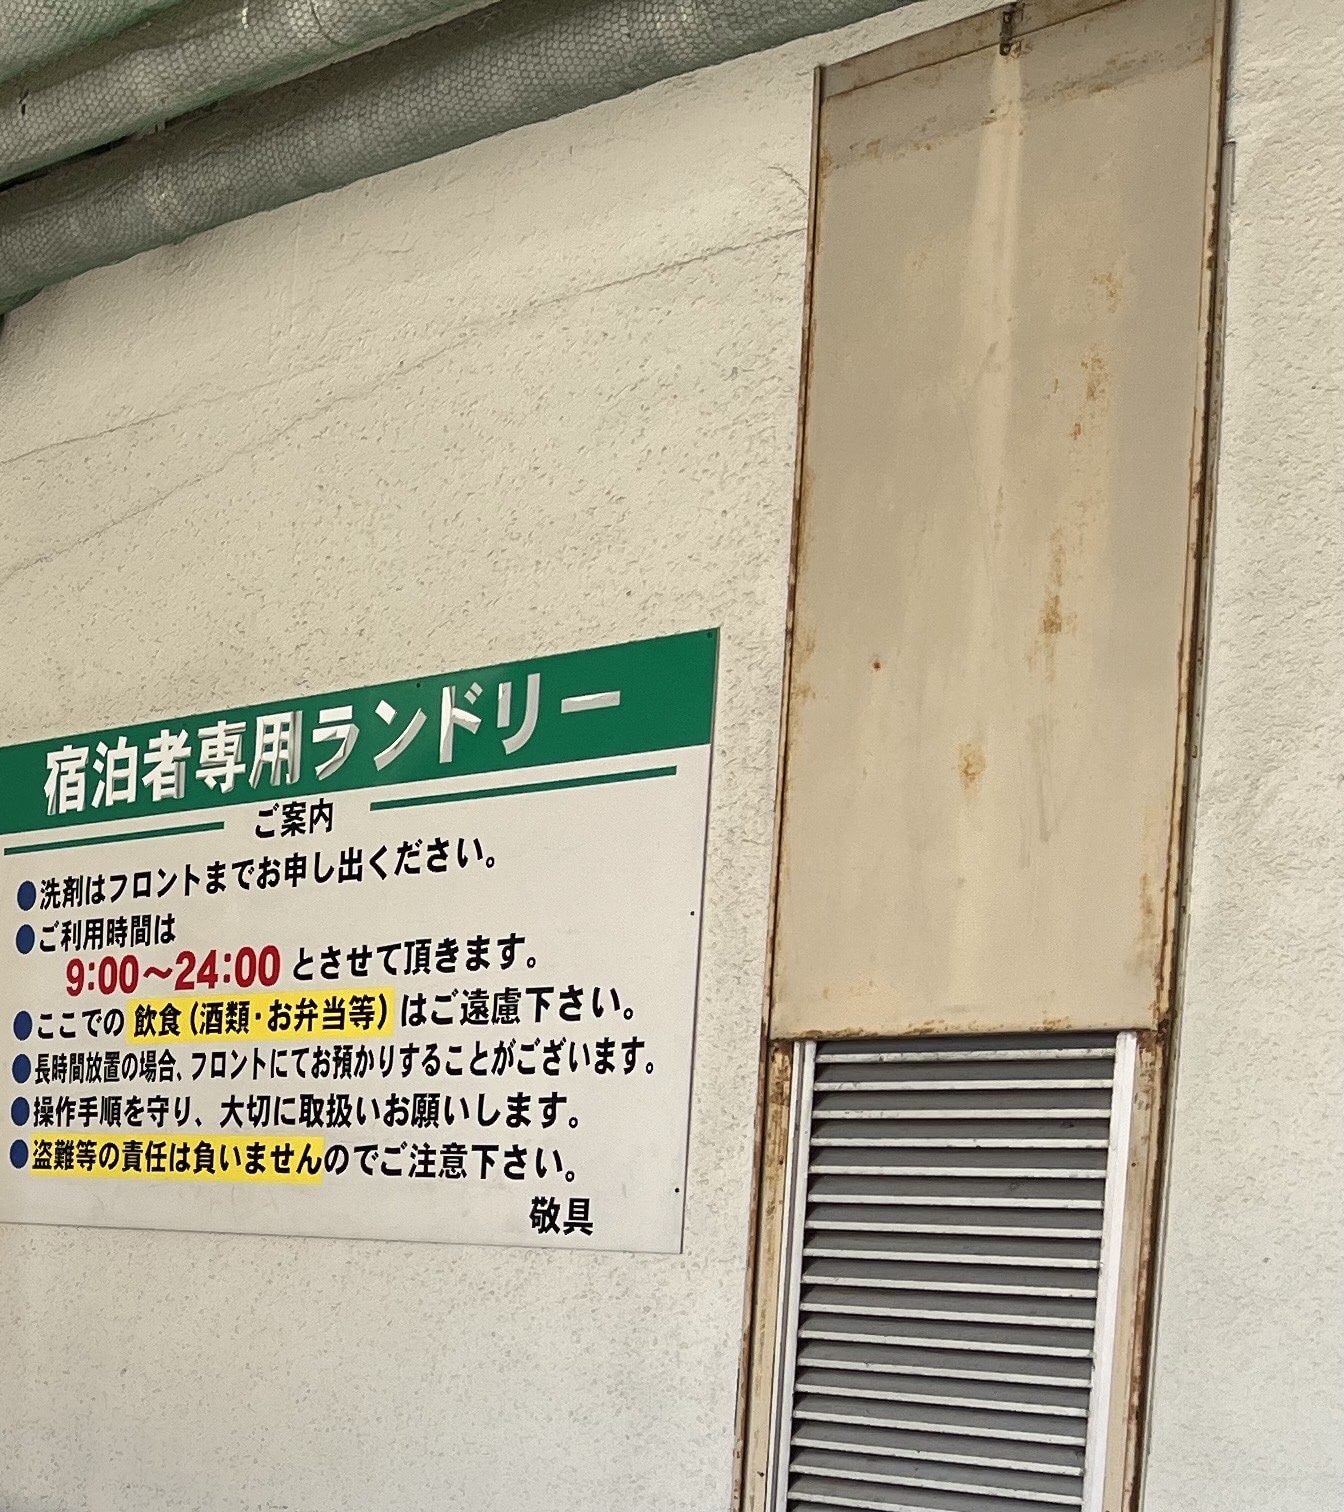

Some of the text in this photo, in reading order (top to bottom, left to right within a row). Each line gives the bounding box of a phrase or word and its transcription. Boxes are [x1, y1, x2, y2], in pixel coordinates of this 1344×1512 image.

[43, 673, 621, 816] 宿泊者専用ランドリー
[255, 798, 334, 838] ご案内
[39, 837, 495, 910] 洗剤はフロントまでお申し出ください。
[39, 913, 176, 952] ご利用時間は
[292, 933, 537, 981] とさせて頂きます。
[37, 1009, 124, 1039] ここでの
[400, 985, 633, 1027] はご遠慮下さい。
[34, 1036, 654, 1085] 長時間放置の場合、フロントにてお預かりすることがございます。
[33, 1092, 579, 1129] 操作手順を守り、大切に取扱いお願いします。
[32, 1139, 575, 1183] 盗難等の責任は負いませんのでご注意下さい。
[529, 1197, 594, 1236] 敬具
